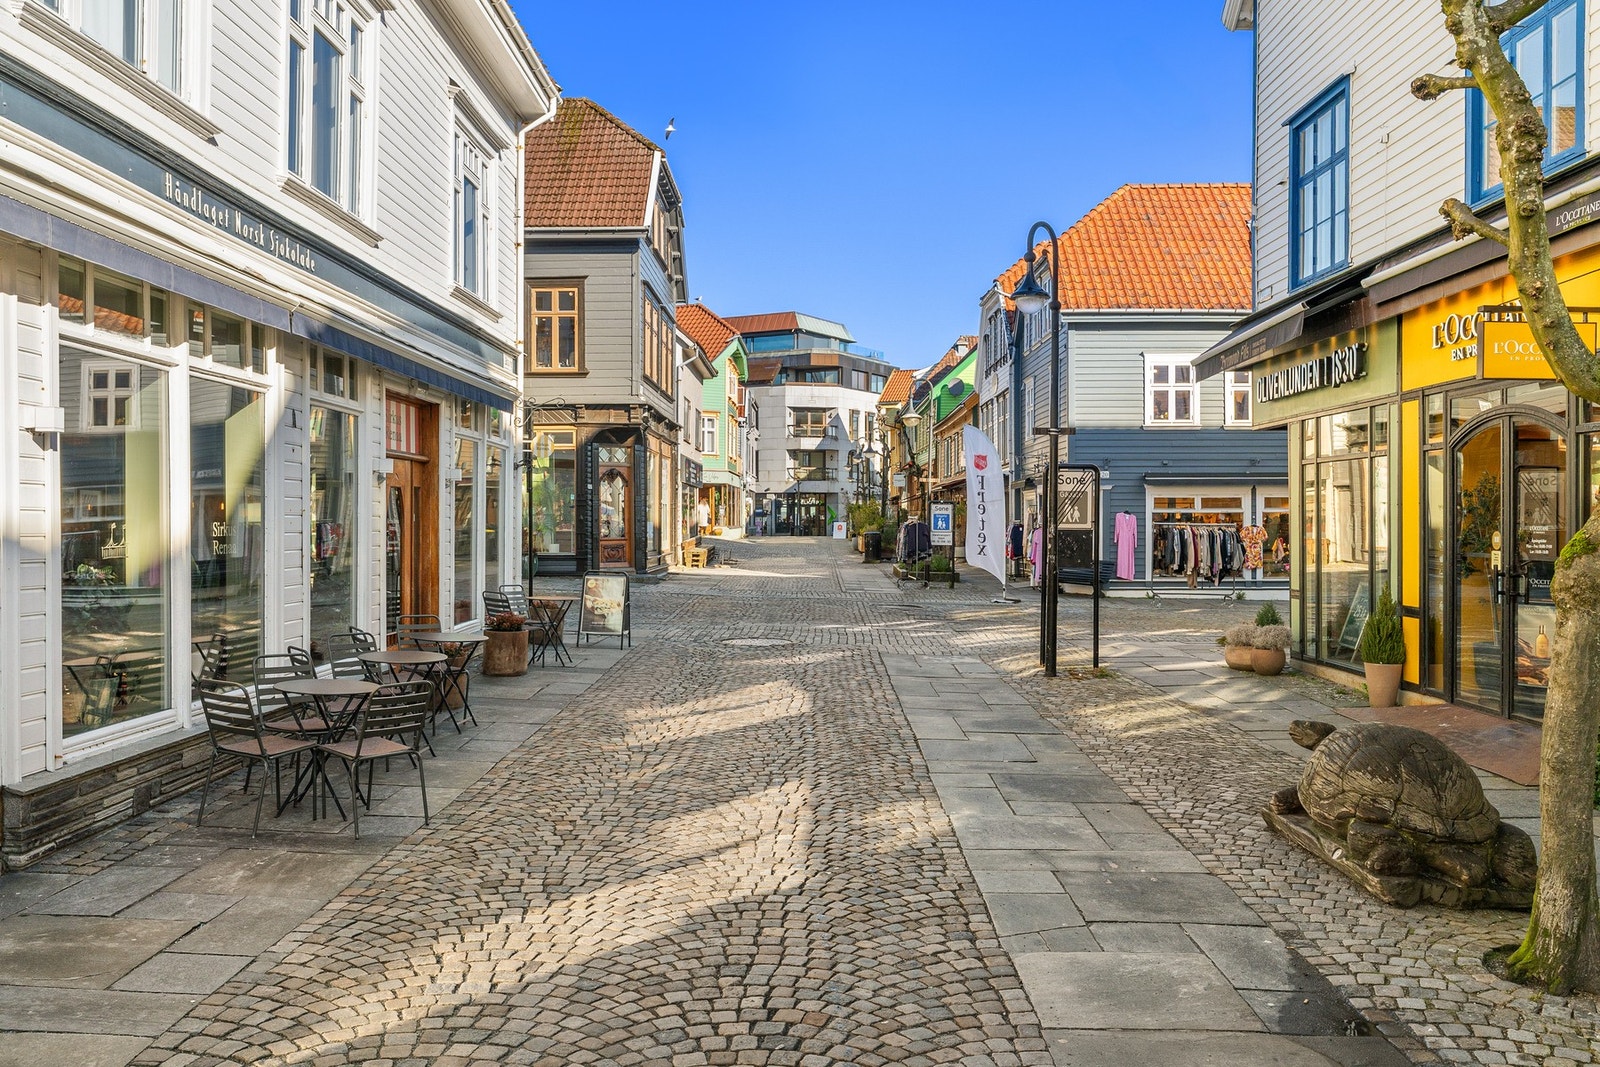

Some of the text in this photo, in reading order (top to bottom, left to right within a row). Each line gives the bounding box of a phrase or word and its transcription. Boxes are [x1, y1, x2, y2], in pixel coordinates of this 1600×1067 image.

[164, 171, 316, 272] Håndlaget Norsk Sjokolade
[1450, 348, 1464, 361] EN
[1256, 358, 1320, 404] OLIVENLUNDEN
[1057, 474, 1087, 486] Sone
[212, 521, 238, 537] Sirkus
[212, 540, 238, 556] Renaa
